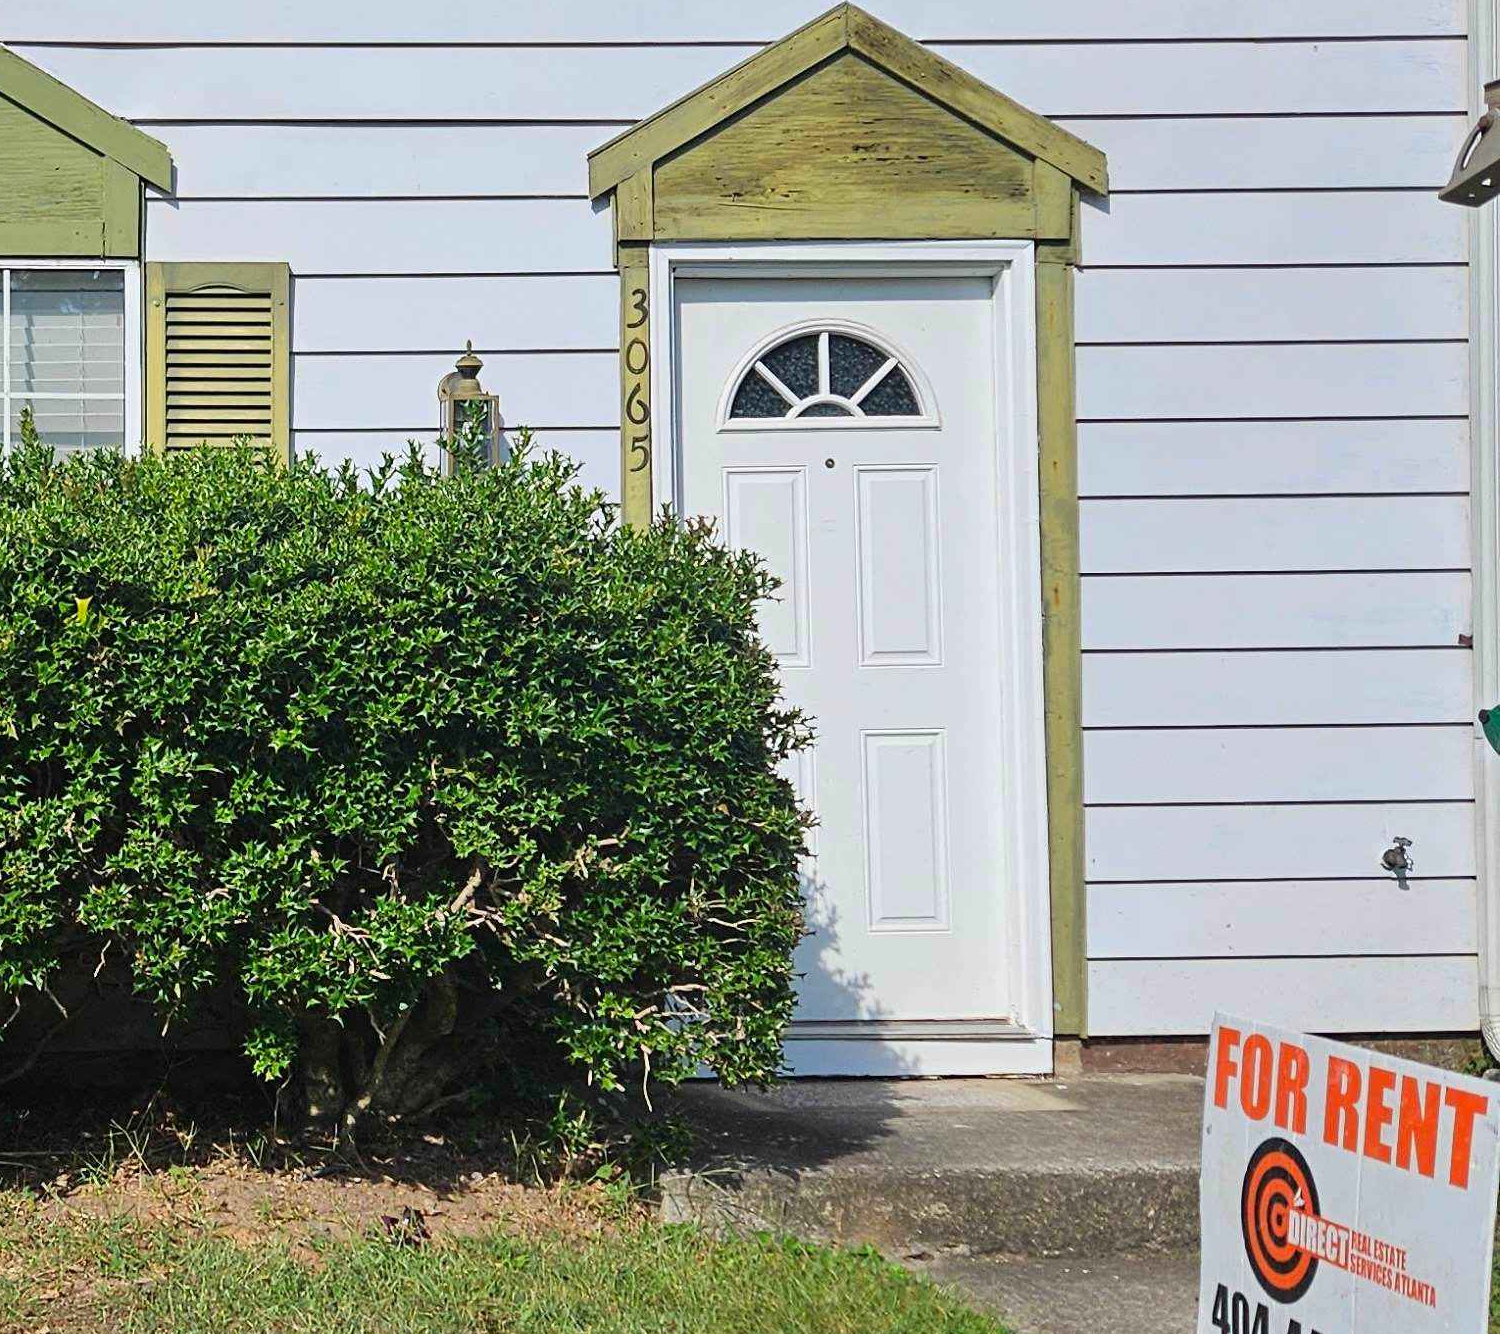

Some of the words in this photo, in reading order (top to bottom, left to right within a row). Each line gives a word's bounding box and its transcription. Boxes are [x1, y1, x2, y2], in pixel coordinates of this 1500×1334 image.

[626, 288, 650, 472] 3065
[1213, 1026, 1309, 1135] FOR
[1323, 1056, 1488, 1190] RENT
[1288, 1210, 1350, 1266] DIRECT
[1351, 1231, 1372, 1255] REAL
[1373, 1240, 1406, 1270] ESTATE
[1349, 1254, 1393, 1288] SERVICES
[1394, 1273, 1436, 1307] ATLANTA
